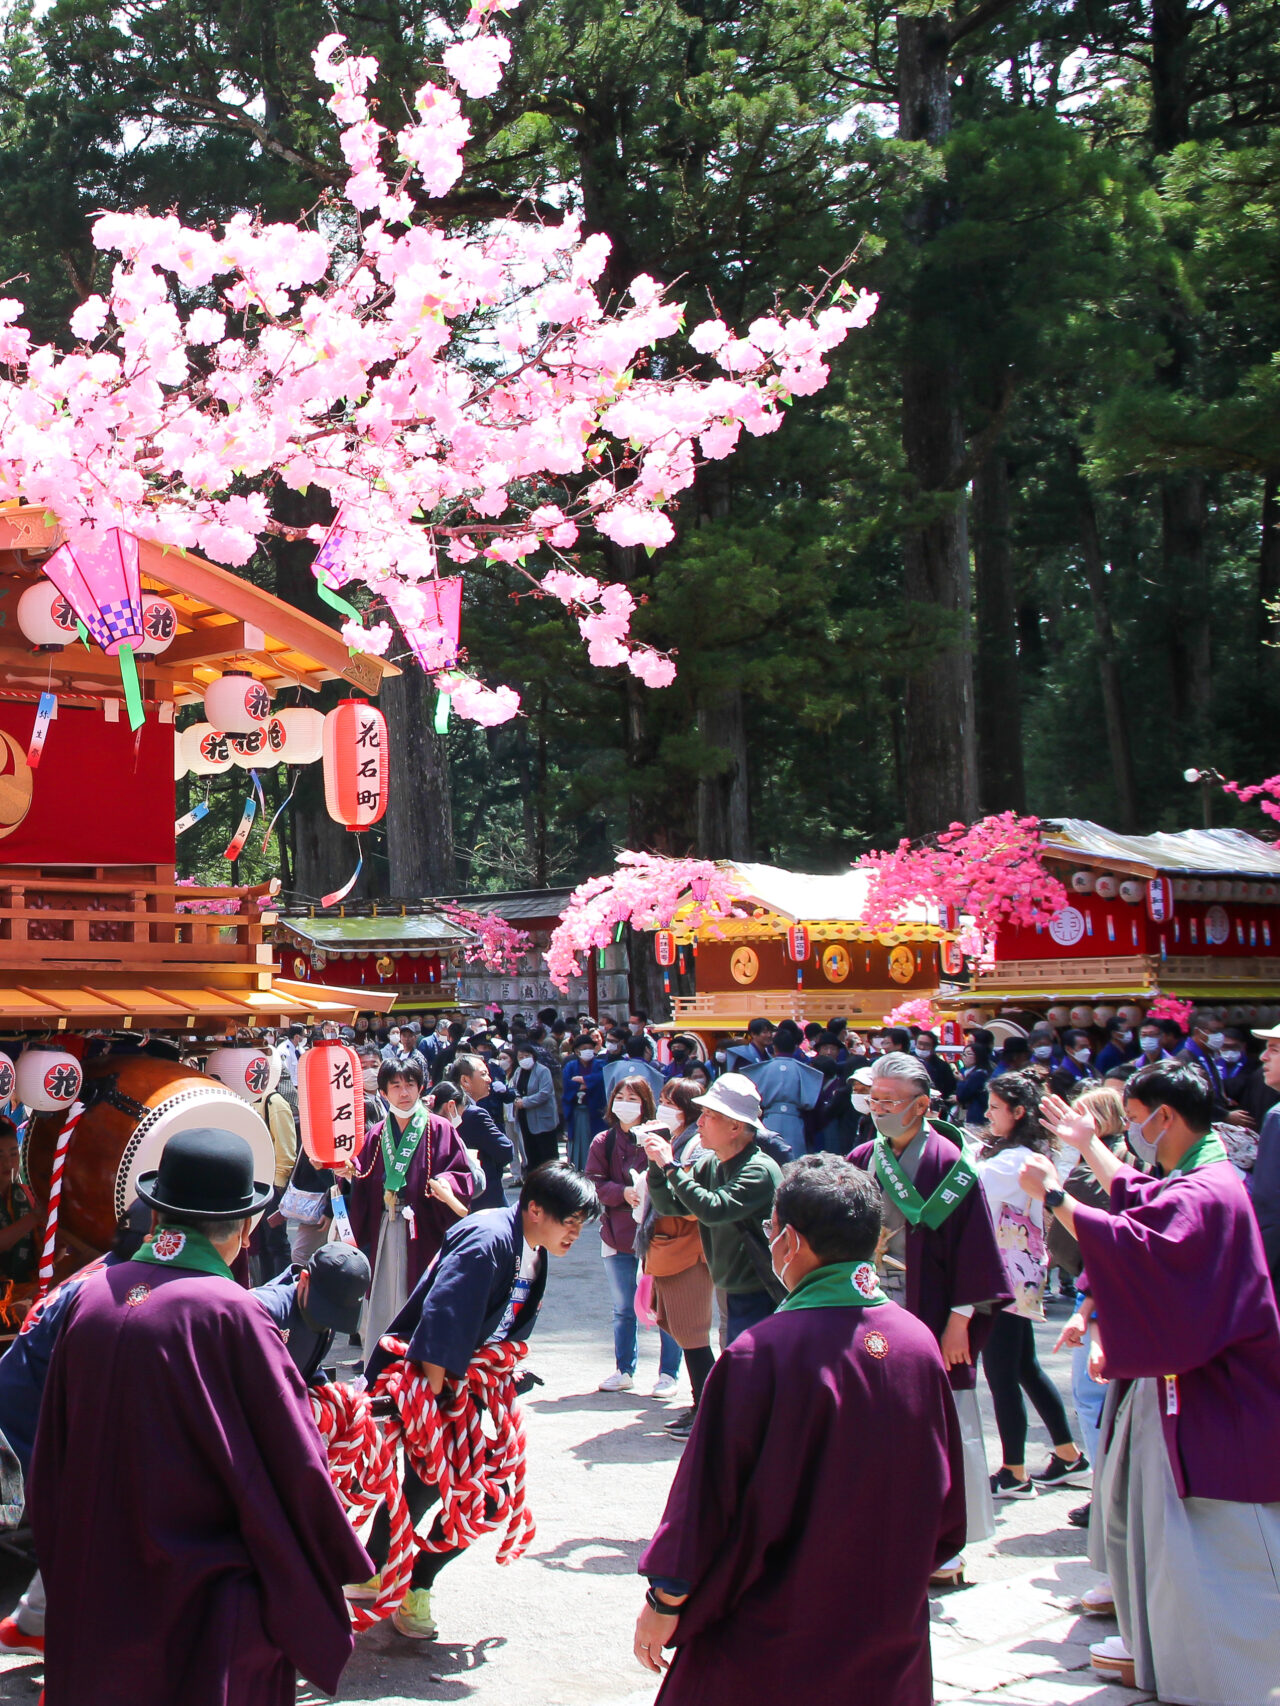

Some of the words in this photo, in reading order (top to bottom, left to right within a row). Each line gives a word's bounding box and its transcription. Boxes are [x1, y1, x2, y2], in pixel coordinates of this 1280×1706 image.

[147, 605, 174, 637] 花
[248, 688, 269, 717] 花
[31, 709, 50, 759] 弥生祭
[205, 734, 228, 760] 花
[236, 729, 262, 753] 花
[355, 719, 381, 811] 花石町
[48, 1066, 78, 1097] 花
[248, 1062, 270, 1092] 花
[330, 1061, 355, 1152] 花石町
[394, 1132, 418, 1172] 花石町
[940, 1171, 972, 1205] 石町
